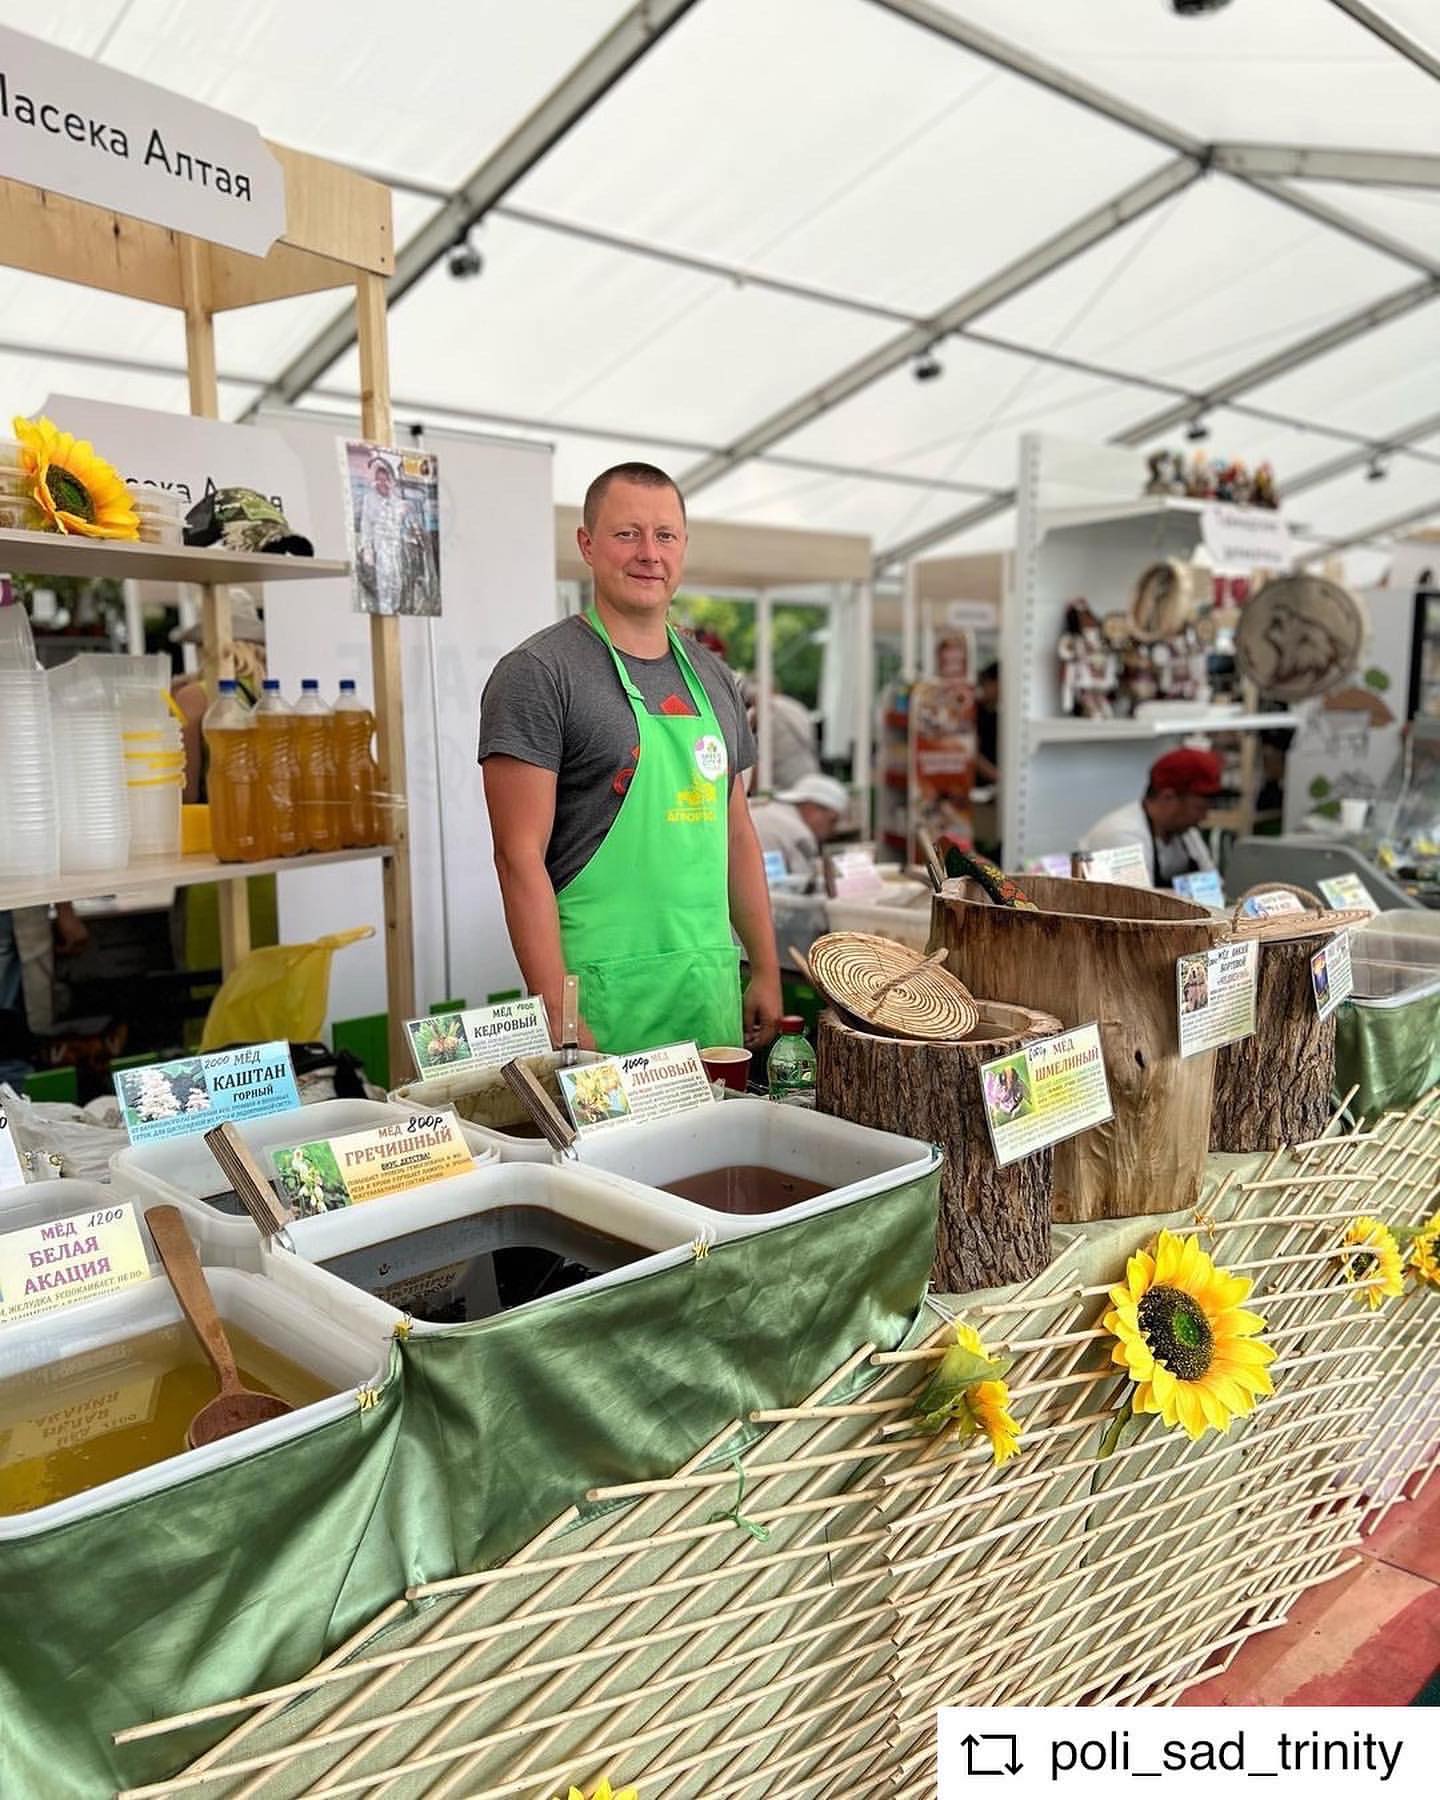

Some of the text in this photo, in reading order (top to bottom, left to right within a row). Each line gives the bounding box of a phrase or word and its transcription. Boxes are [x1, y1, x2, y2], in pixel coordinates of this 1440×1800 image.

[144, 129, 251, 201] Алтая
[474, 1013, 537, 1038] КЕДРОВЫЙ
[492, 1006, 513, 1018] МЁД
[204, 1050, 261, 1069] 2000 МЁД
[1053, 1038, 1074, 1055] МЁД
[213, 1063, 286, 1091] КАШТАН
[631, 1058, 698, 1087] ЛИПОВЫЙ
[1035, 1045, 1099, 1082] ШМЕЛИНЫЙ
[233, 1086, 273, 1102] ГОРНЫЙ
[344, 1126, 453, 1166] ГРЕЧИШНЫЙ
[378, 1126, 401, 1138] МЁД
[40, 1208, 123, 1240] МЁД 1200
[28, 1236, 99, 1268] БЕЛАЯ
[24, 1257, 112, 1295] АКАЦИЯ
